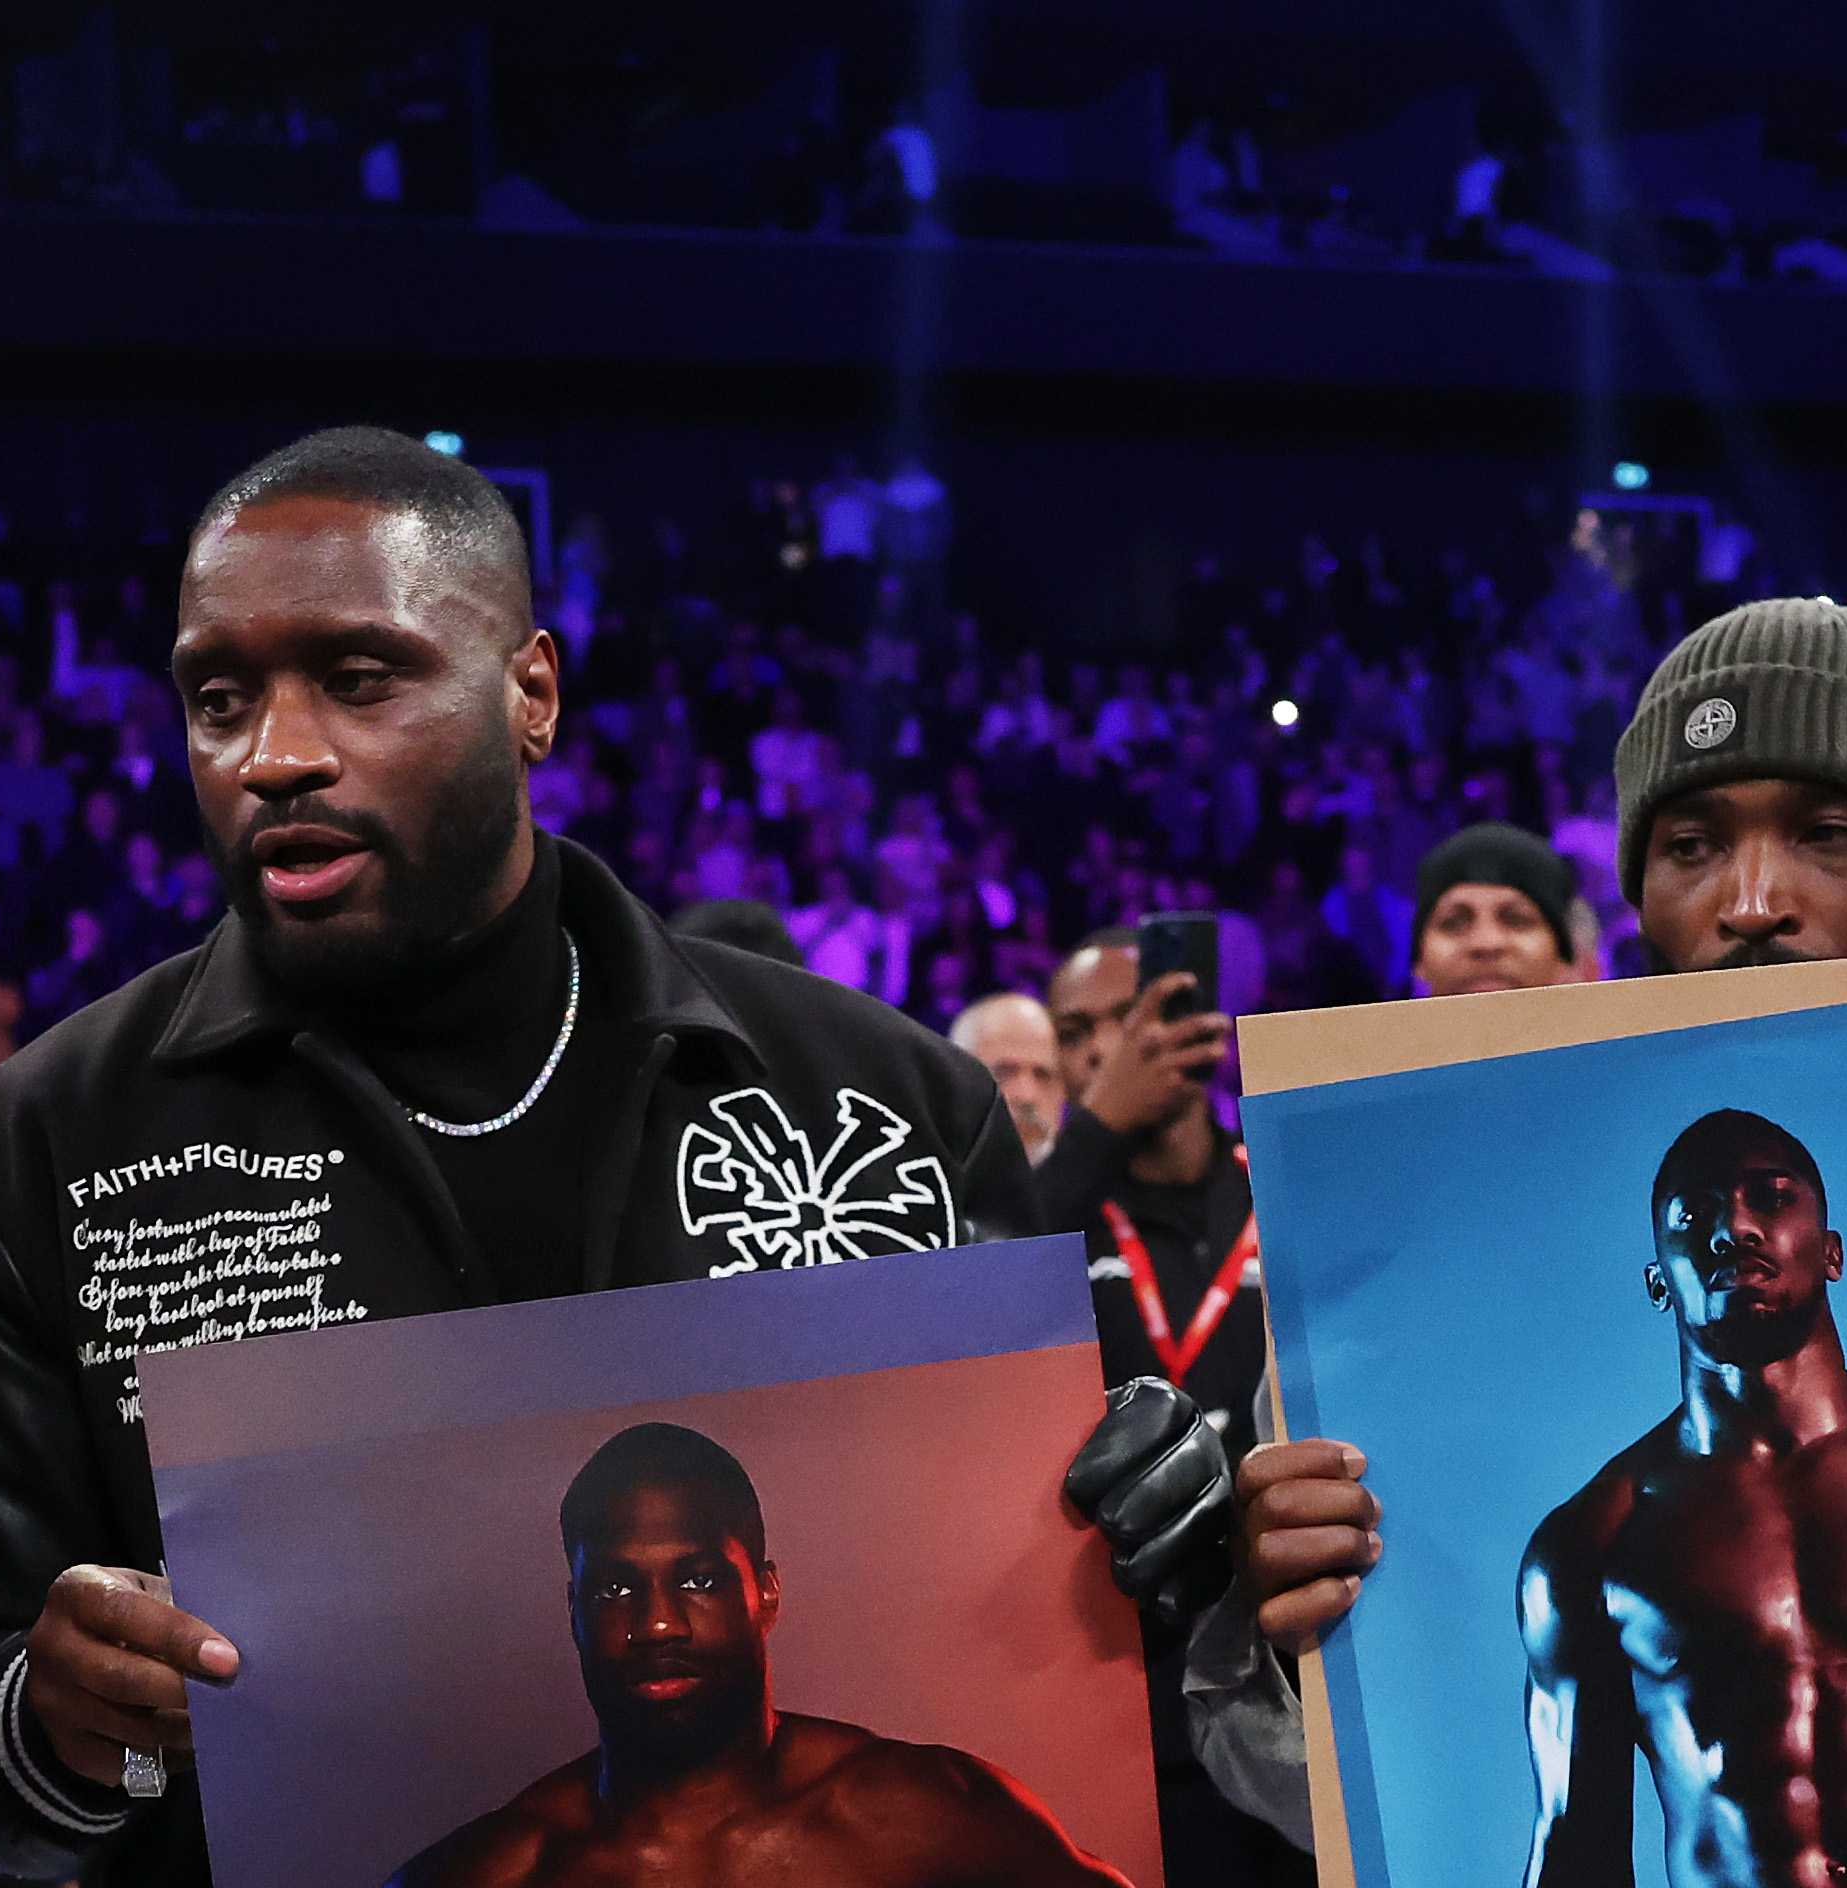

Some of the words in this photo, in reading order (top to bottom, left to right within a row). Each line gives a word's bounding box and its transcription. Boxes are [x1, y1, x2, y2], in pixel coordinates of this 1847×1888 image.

[73, 1218, 122, 1253] Every
[125, 1217, 193, 1249] fortune
[223, 1192, 332, 1223] accumulated
[93, 1248, 152, 1272] started
[208, 1230, 243, 1256] leap
[79, 1275, 144, 1311] Before
[144, 1280, 182, 1309] you
[214, 1251, 252, 1279] that
[253, 1251, 287, 1279] leap
[288, 1249, 330, 1270] take
[104, 1309, 146, 1340] long
[148, 1299, 189, 1327] hard
[248, 1272, 325, 1316] yourself
[178, 1319, 245, 1346] willing
[345, 1298, 368, 1319] to
